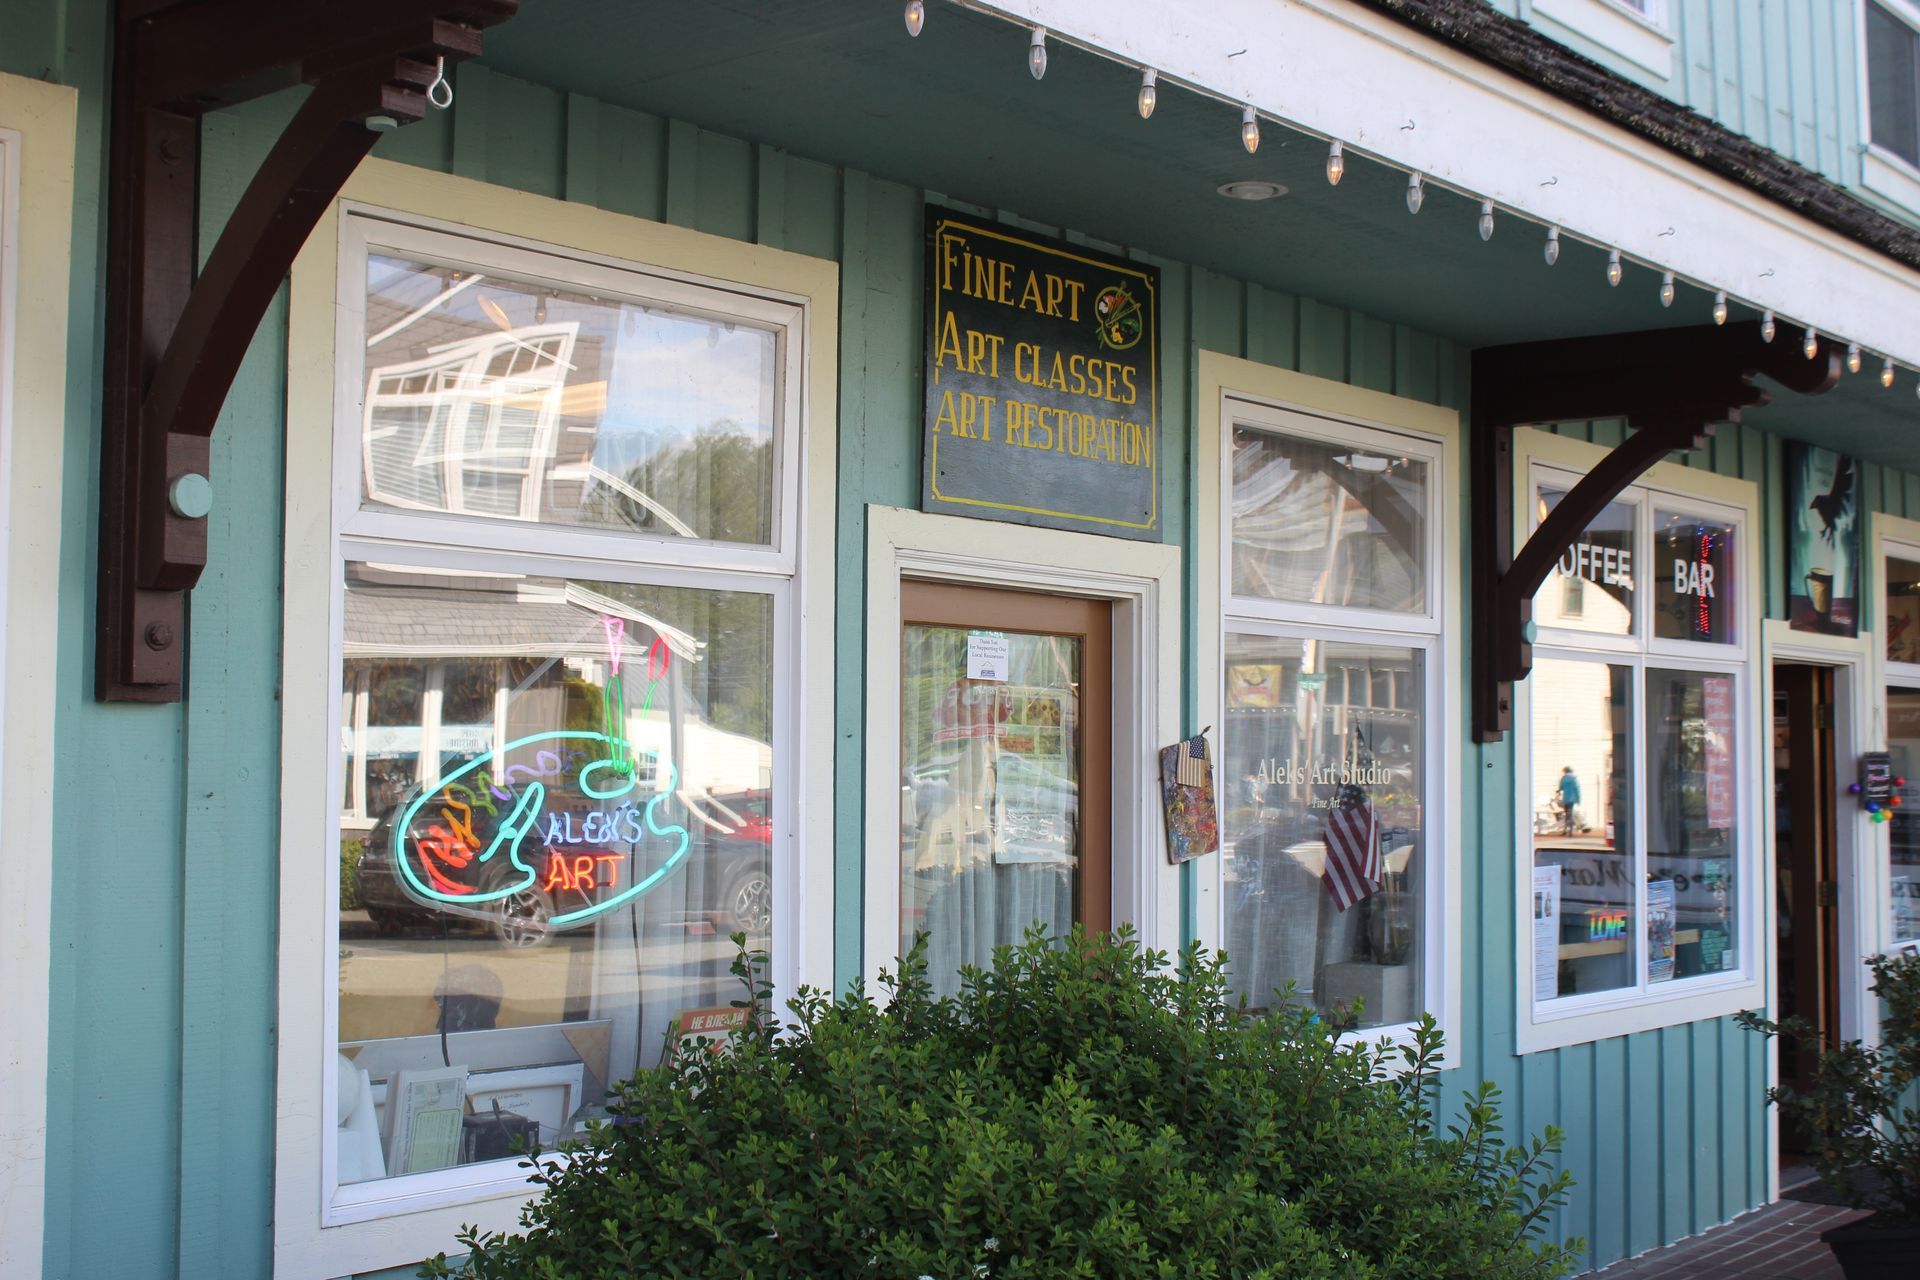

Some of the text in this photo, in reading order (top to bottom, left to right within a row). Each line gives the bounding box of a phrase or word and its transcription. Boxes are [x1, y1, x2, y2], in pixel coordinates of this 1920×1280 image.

[1018, 270, 1085, 322] ART
[937, 311, 1137, 405] ART CLASSES
[932, 391, 997, 442] ART
[1558, 543, 1715, 598] OFFEE BAR
[1310, 759, 1336, 785] Art
[1341, 759, 1392, 785] Studio
[543, 853, 625, 892] ART
[1589, 909, 1629, 943] LOVE
